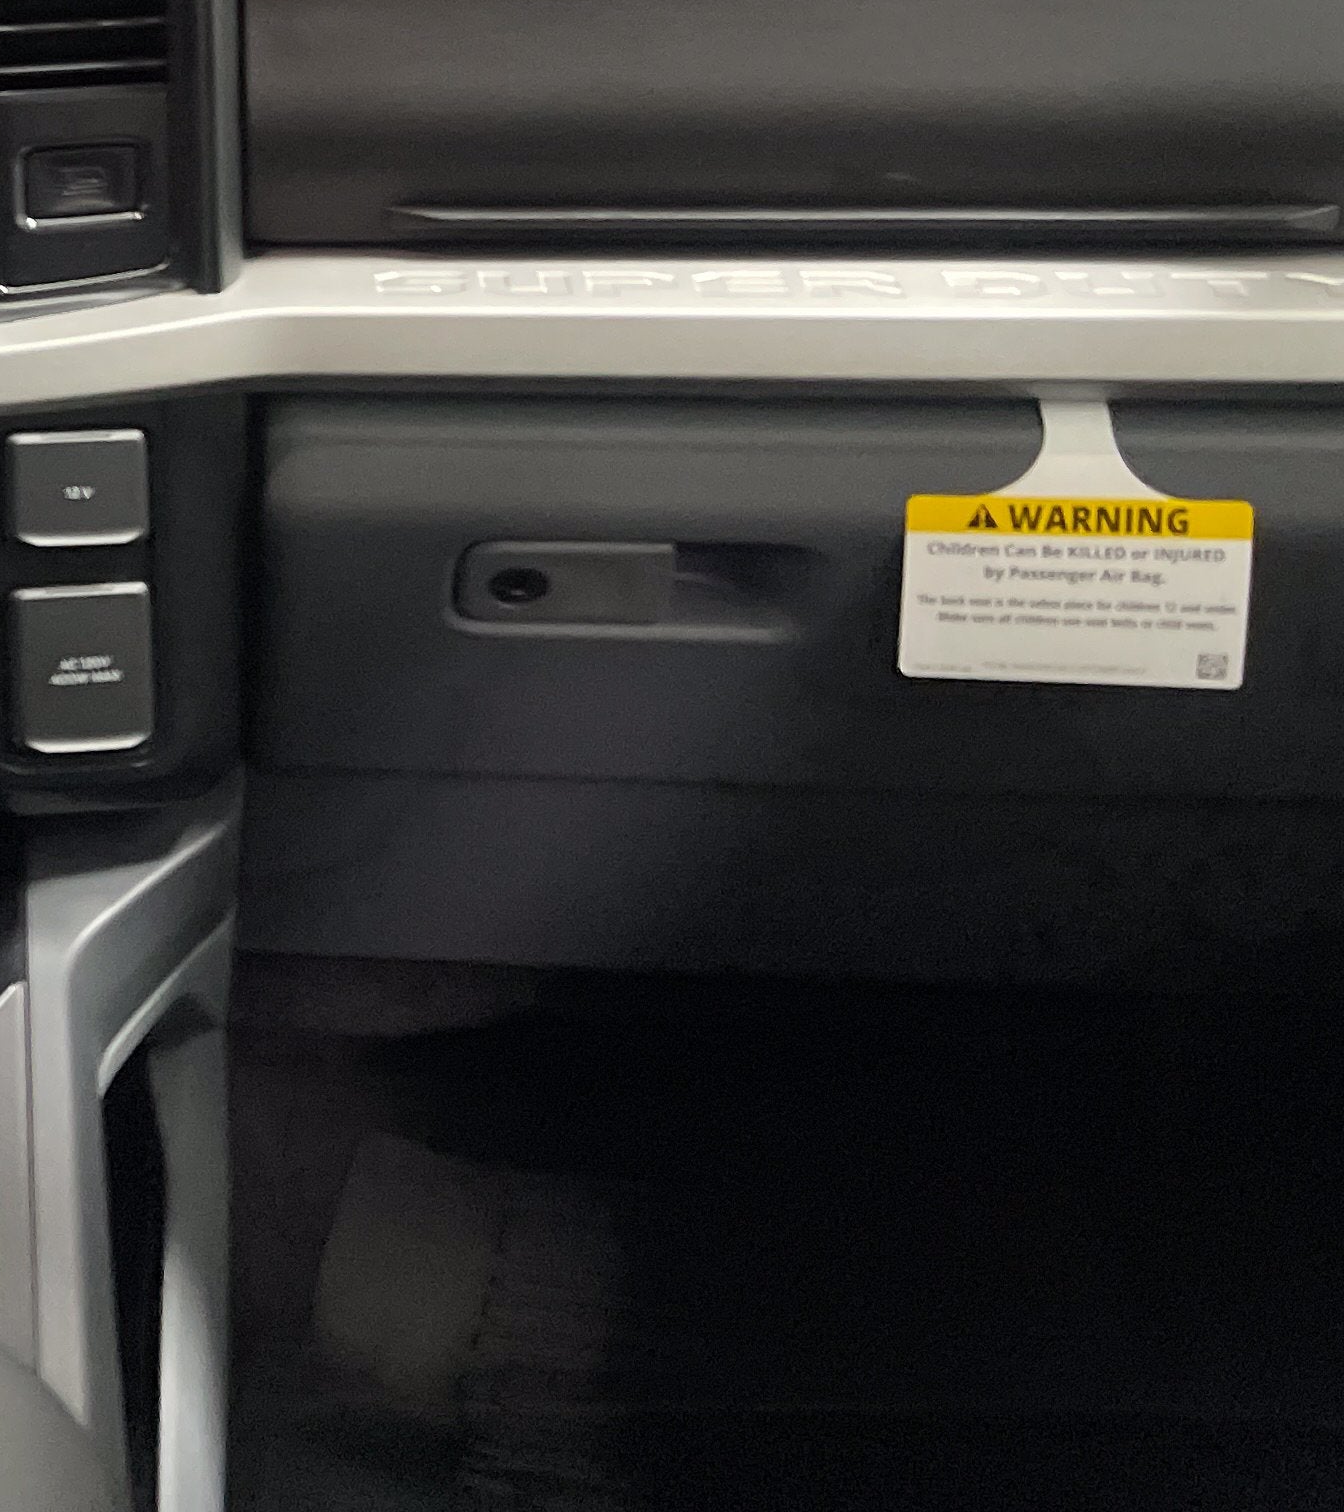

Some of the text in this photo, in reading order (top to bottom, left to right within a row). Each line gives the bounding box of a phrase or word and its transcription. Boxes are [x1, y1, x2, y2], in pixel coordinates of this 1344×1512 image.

[374, 271, 907, 298] SUPER
[1009, 504, 1190, 535] WARNING
[1067, 545, 1126, 561] KILLED
[1153, 547, 1227, 564] INJURED
